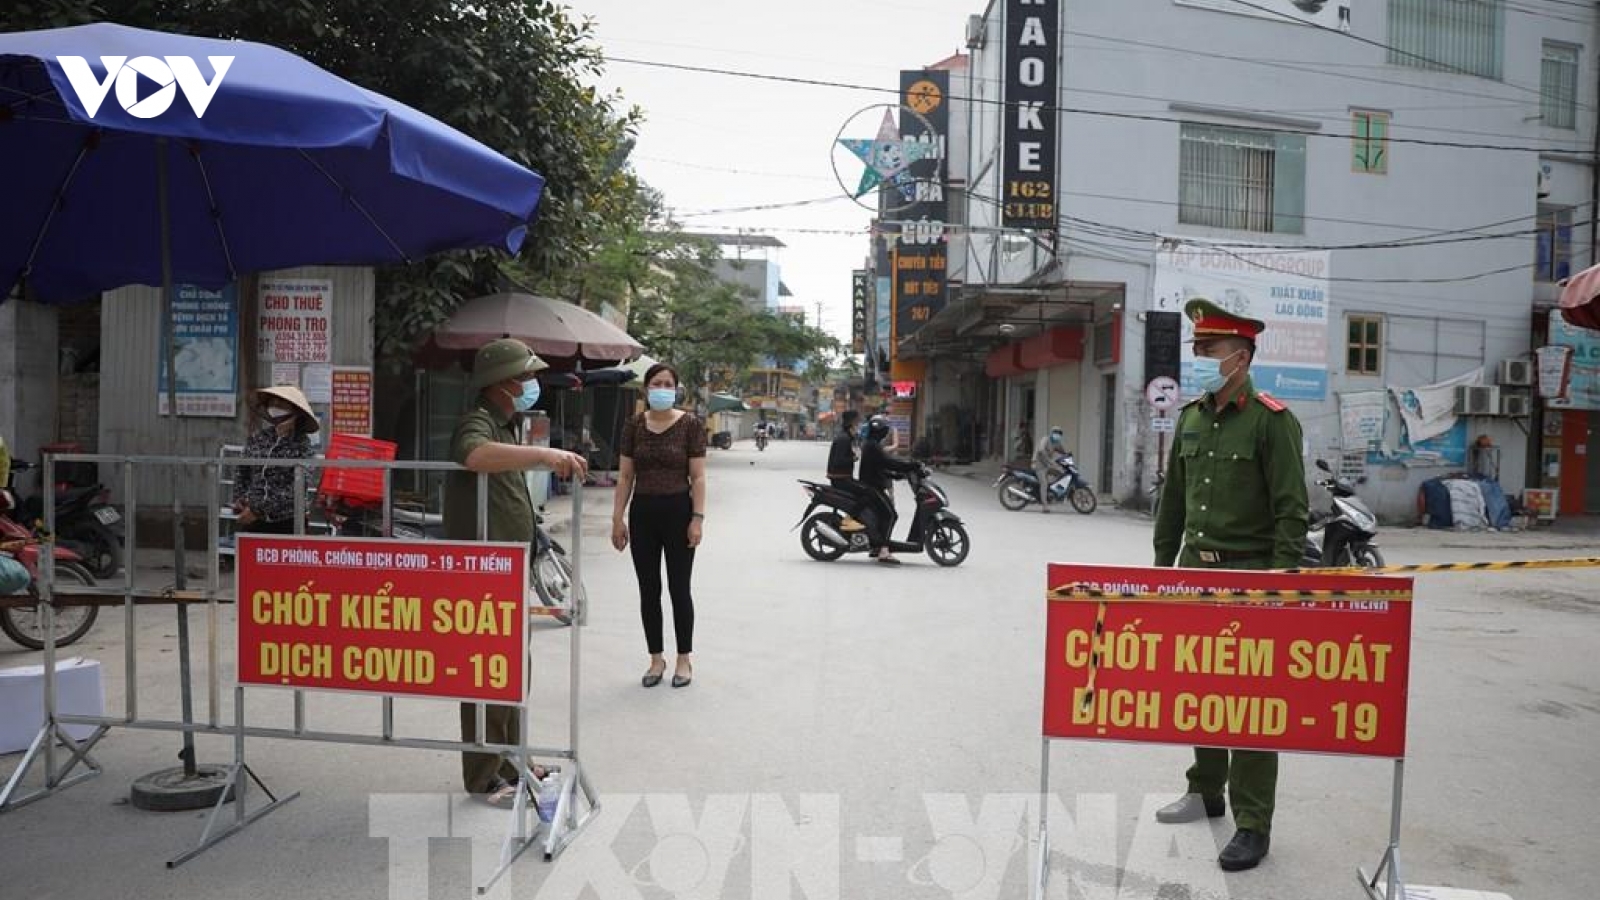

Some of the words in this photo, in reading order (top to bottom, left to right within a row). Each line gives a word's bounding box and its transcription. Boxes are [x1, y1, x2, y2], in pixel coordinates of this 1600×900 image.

[1018, 0, 1047, 172] AOKE
[1010, 181, 1050, 198] 162
[1005, 203, 1053, 219] CLUB
[265, 294, 290, 310] CHO
[294, 292, 323, 311] THUÊ
[260, 312, 301, 332] PHÒNG
[256, 547, 279, 563] BCĐ
[282, 546, 322, 566] PHÒNG,
[325, 547, 363, 566] CHỐNG
[366, 552, 393, 569] DỊCH
[395, 554, 428, 569] COVID
[440, 555, 454, 569] 19
[464, 556, 477, 569] TT
[252, 580, 331, 627] CHỐT
[341, 582, 422, 631] KIỂM
[432, 593, 516, 637] SOÁT
[260, 642, 332, 685] DỊCH
[343, 646, 435, 685] COVID
[469, 653, 508, 689] 19
[1065, 618, 1163, 671] CHỐT
[1174, 621, 1274, 677] KIỂM
[1288, 635, 1392, 683] SOÁT
[1072, 687, 1161, 735] DỊCH
[1173, 692, 1288, 736] COVID
[1331, 701, 1379, 741] 19
